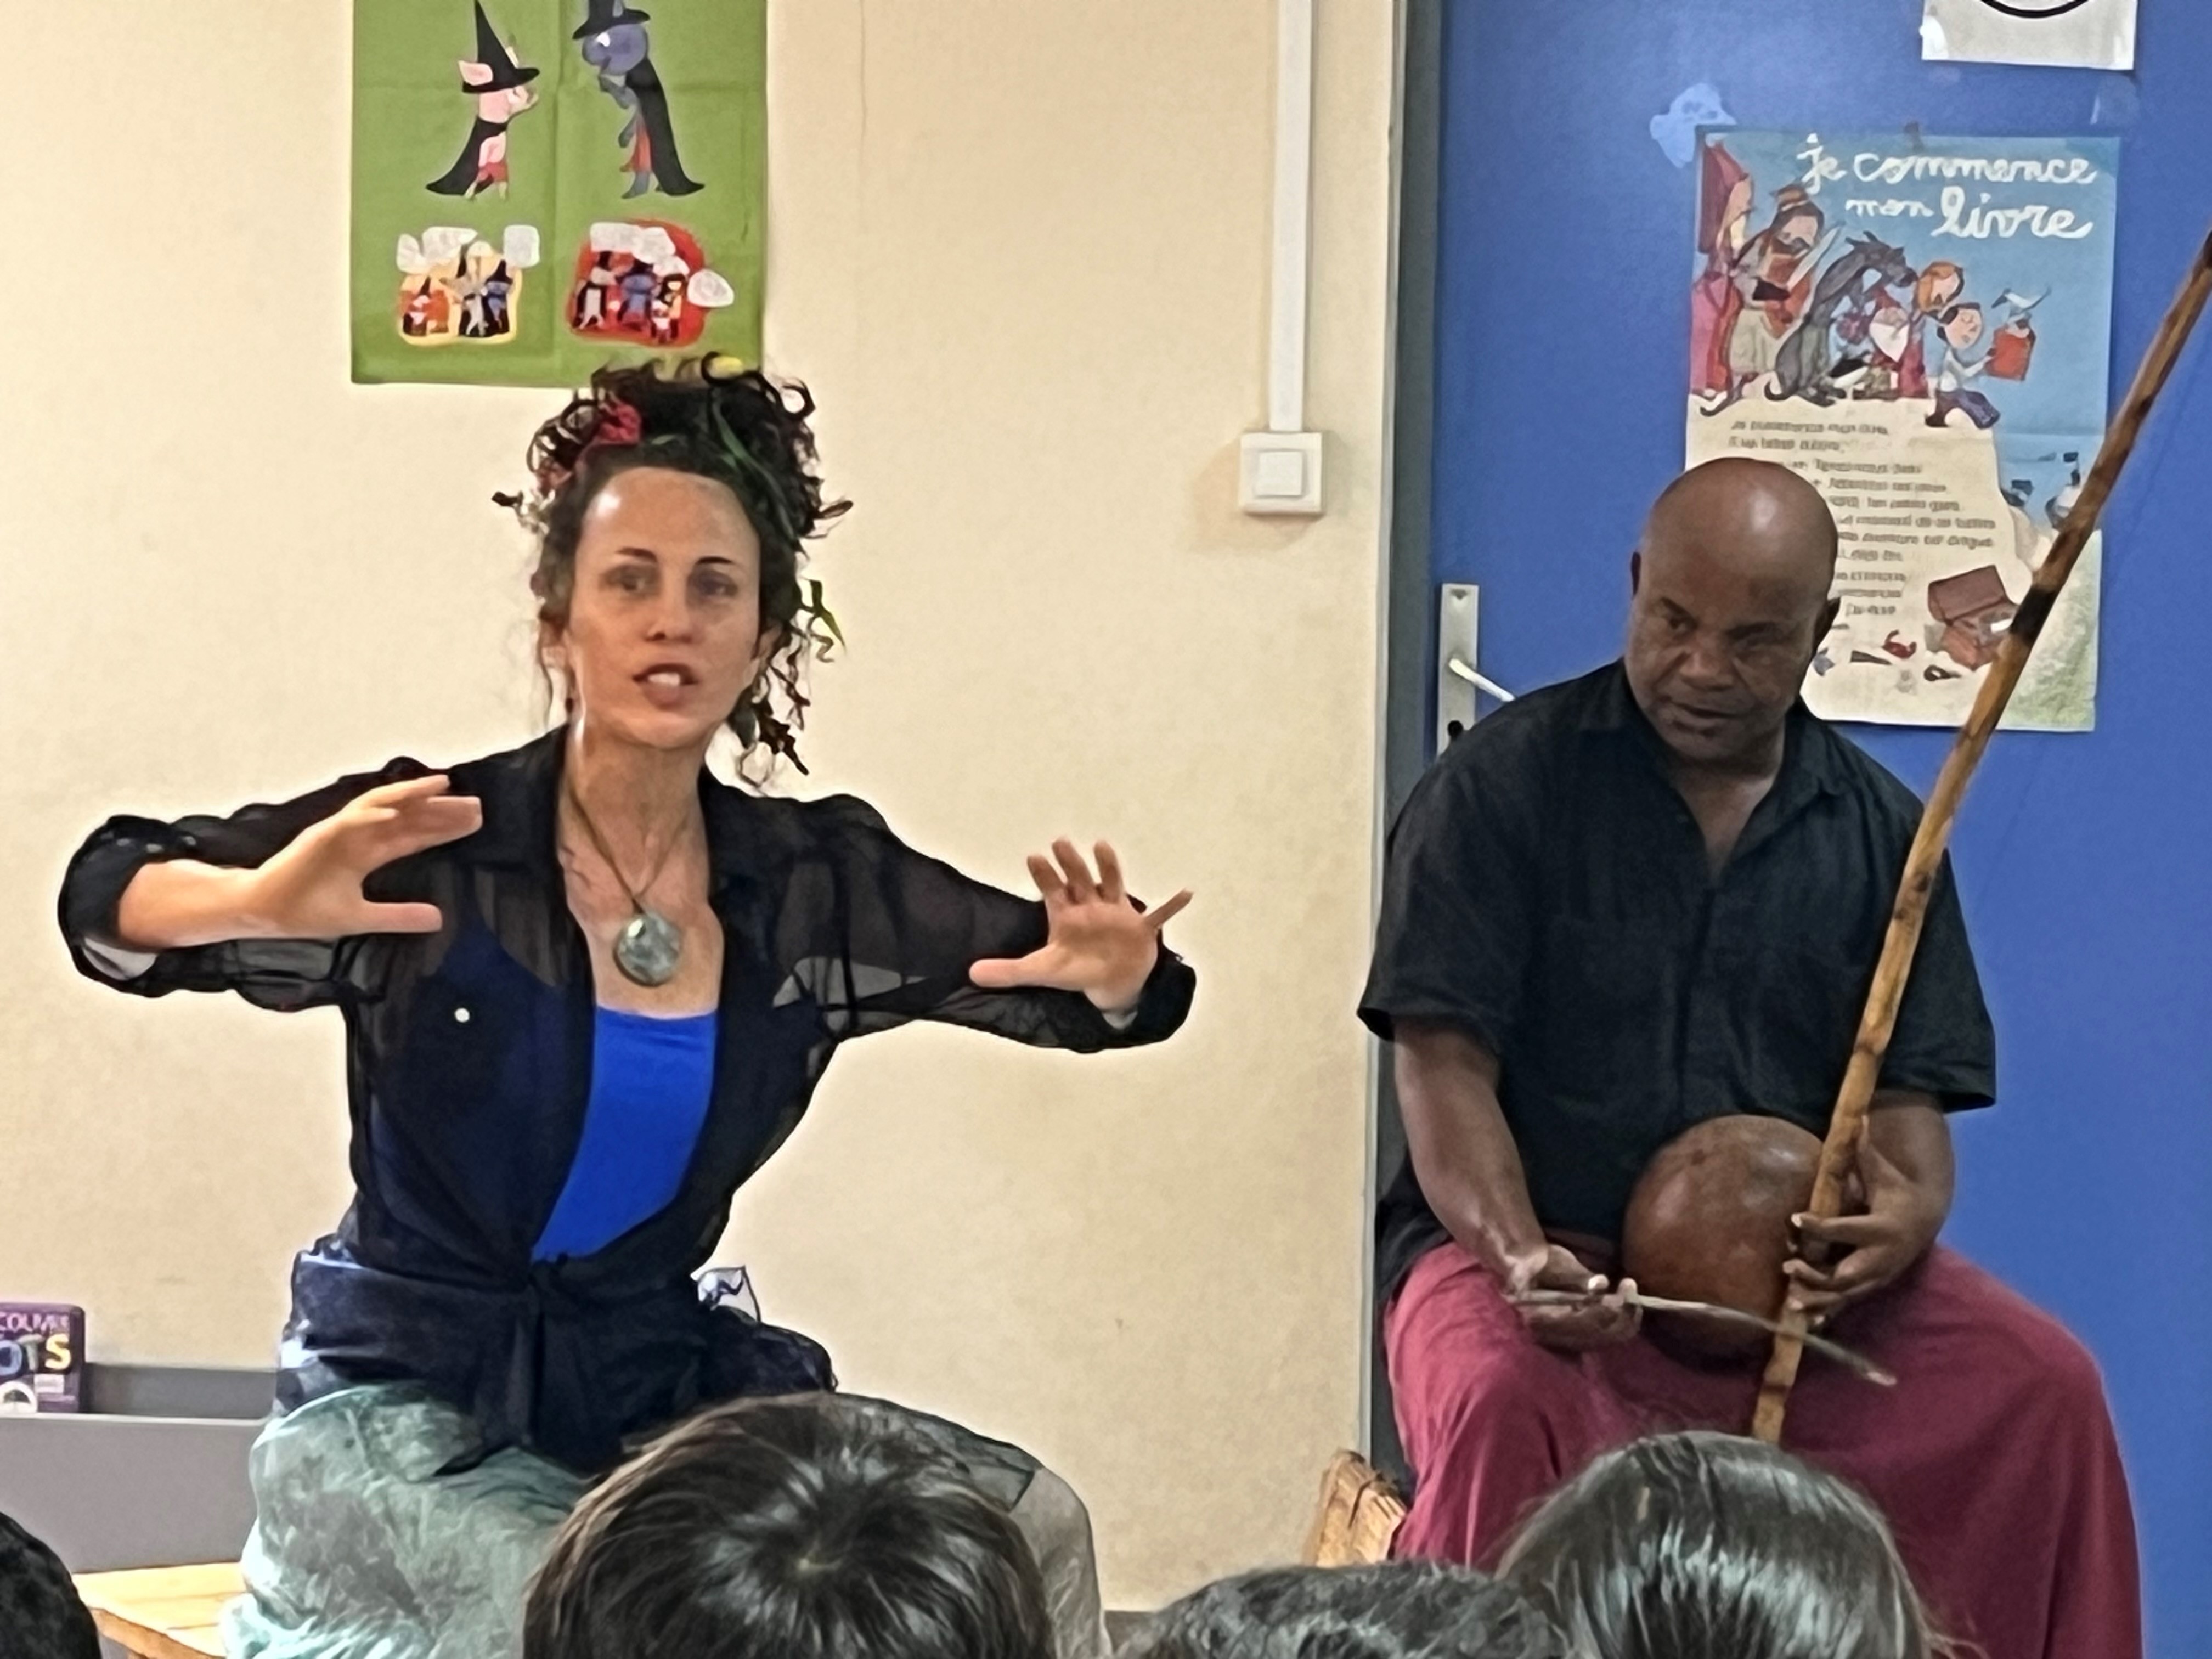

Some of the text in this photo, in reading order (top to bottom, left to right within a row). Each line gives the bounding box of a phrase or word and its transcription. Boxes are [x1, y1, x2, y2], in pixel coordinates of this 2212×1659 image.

[1796, 132, 2098, 194] je commence
[1845, 185, 2094, 239] mon livre
